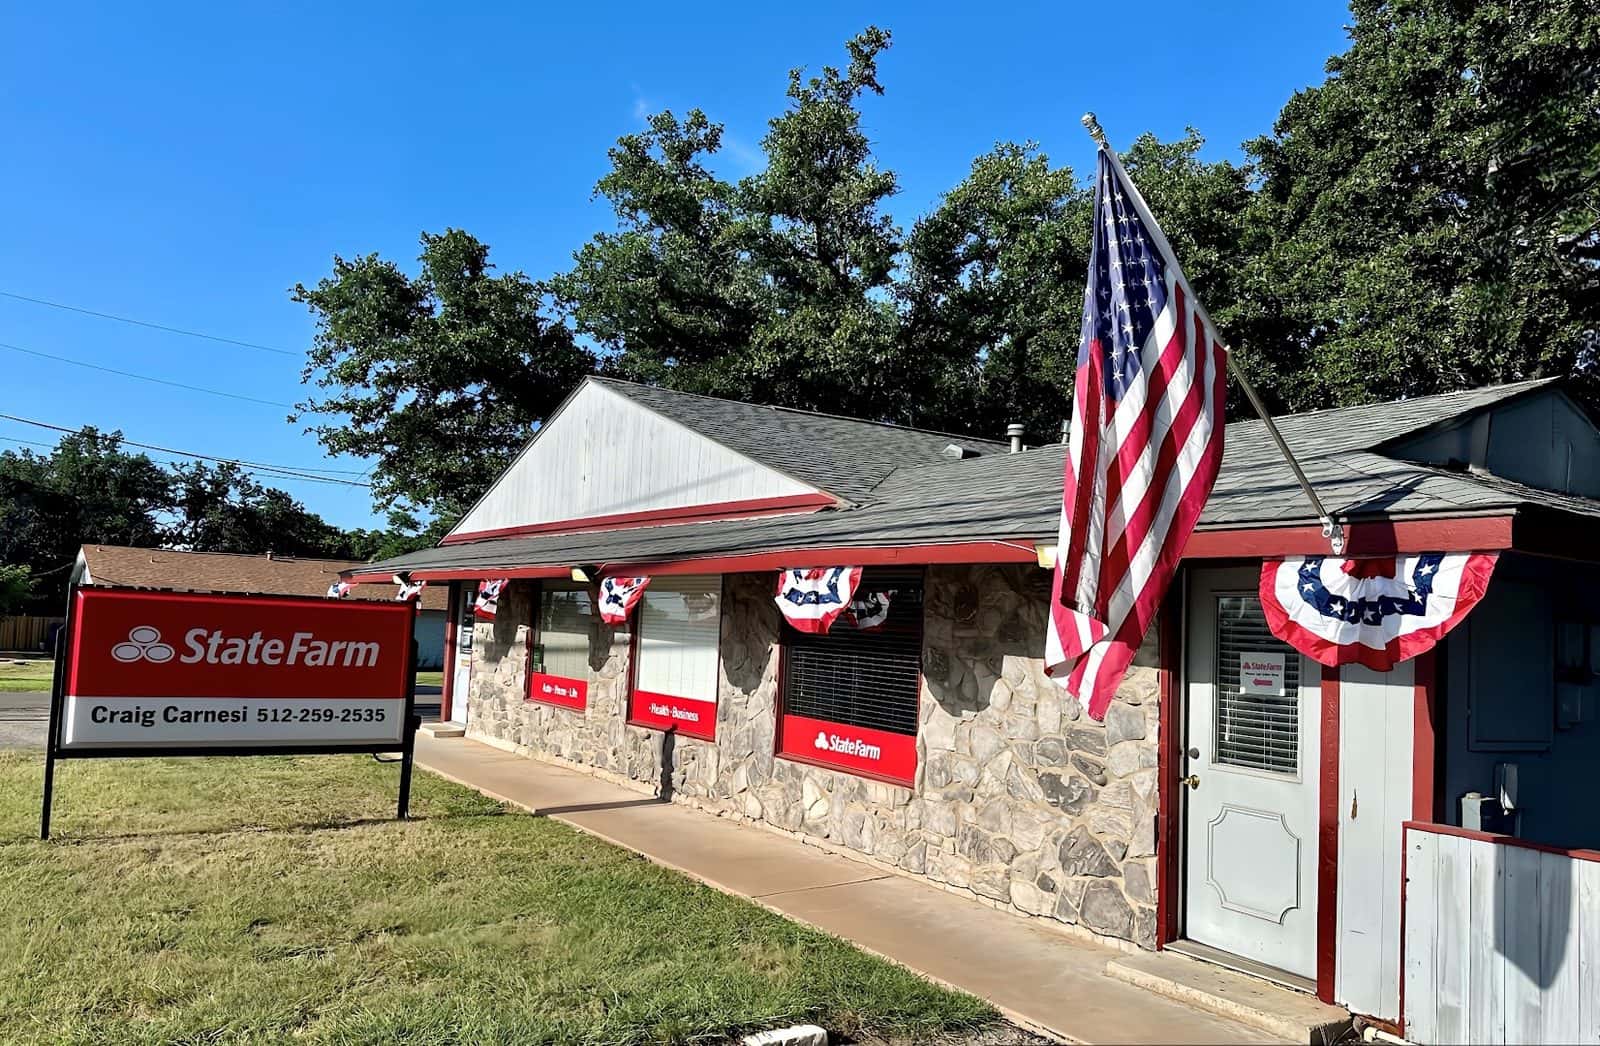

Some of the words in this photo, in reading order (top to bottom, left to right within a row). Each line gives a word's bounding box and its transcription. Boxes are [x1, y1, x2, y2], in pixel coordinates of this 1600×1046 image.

[91, 705, 156, 728] Craig
[163, 705, 248, 723] Carnesi
[257, 708, 386, 722] 512-259-2535
[651, 702, 670, 717] Health
[671, 705, 699, 722] Business
